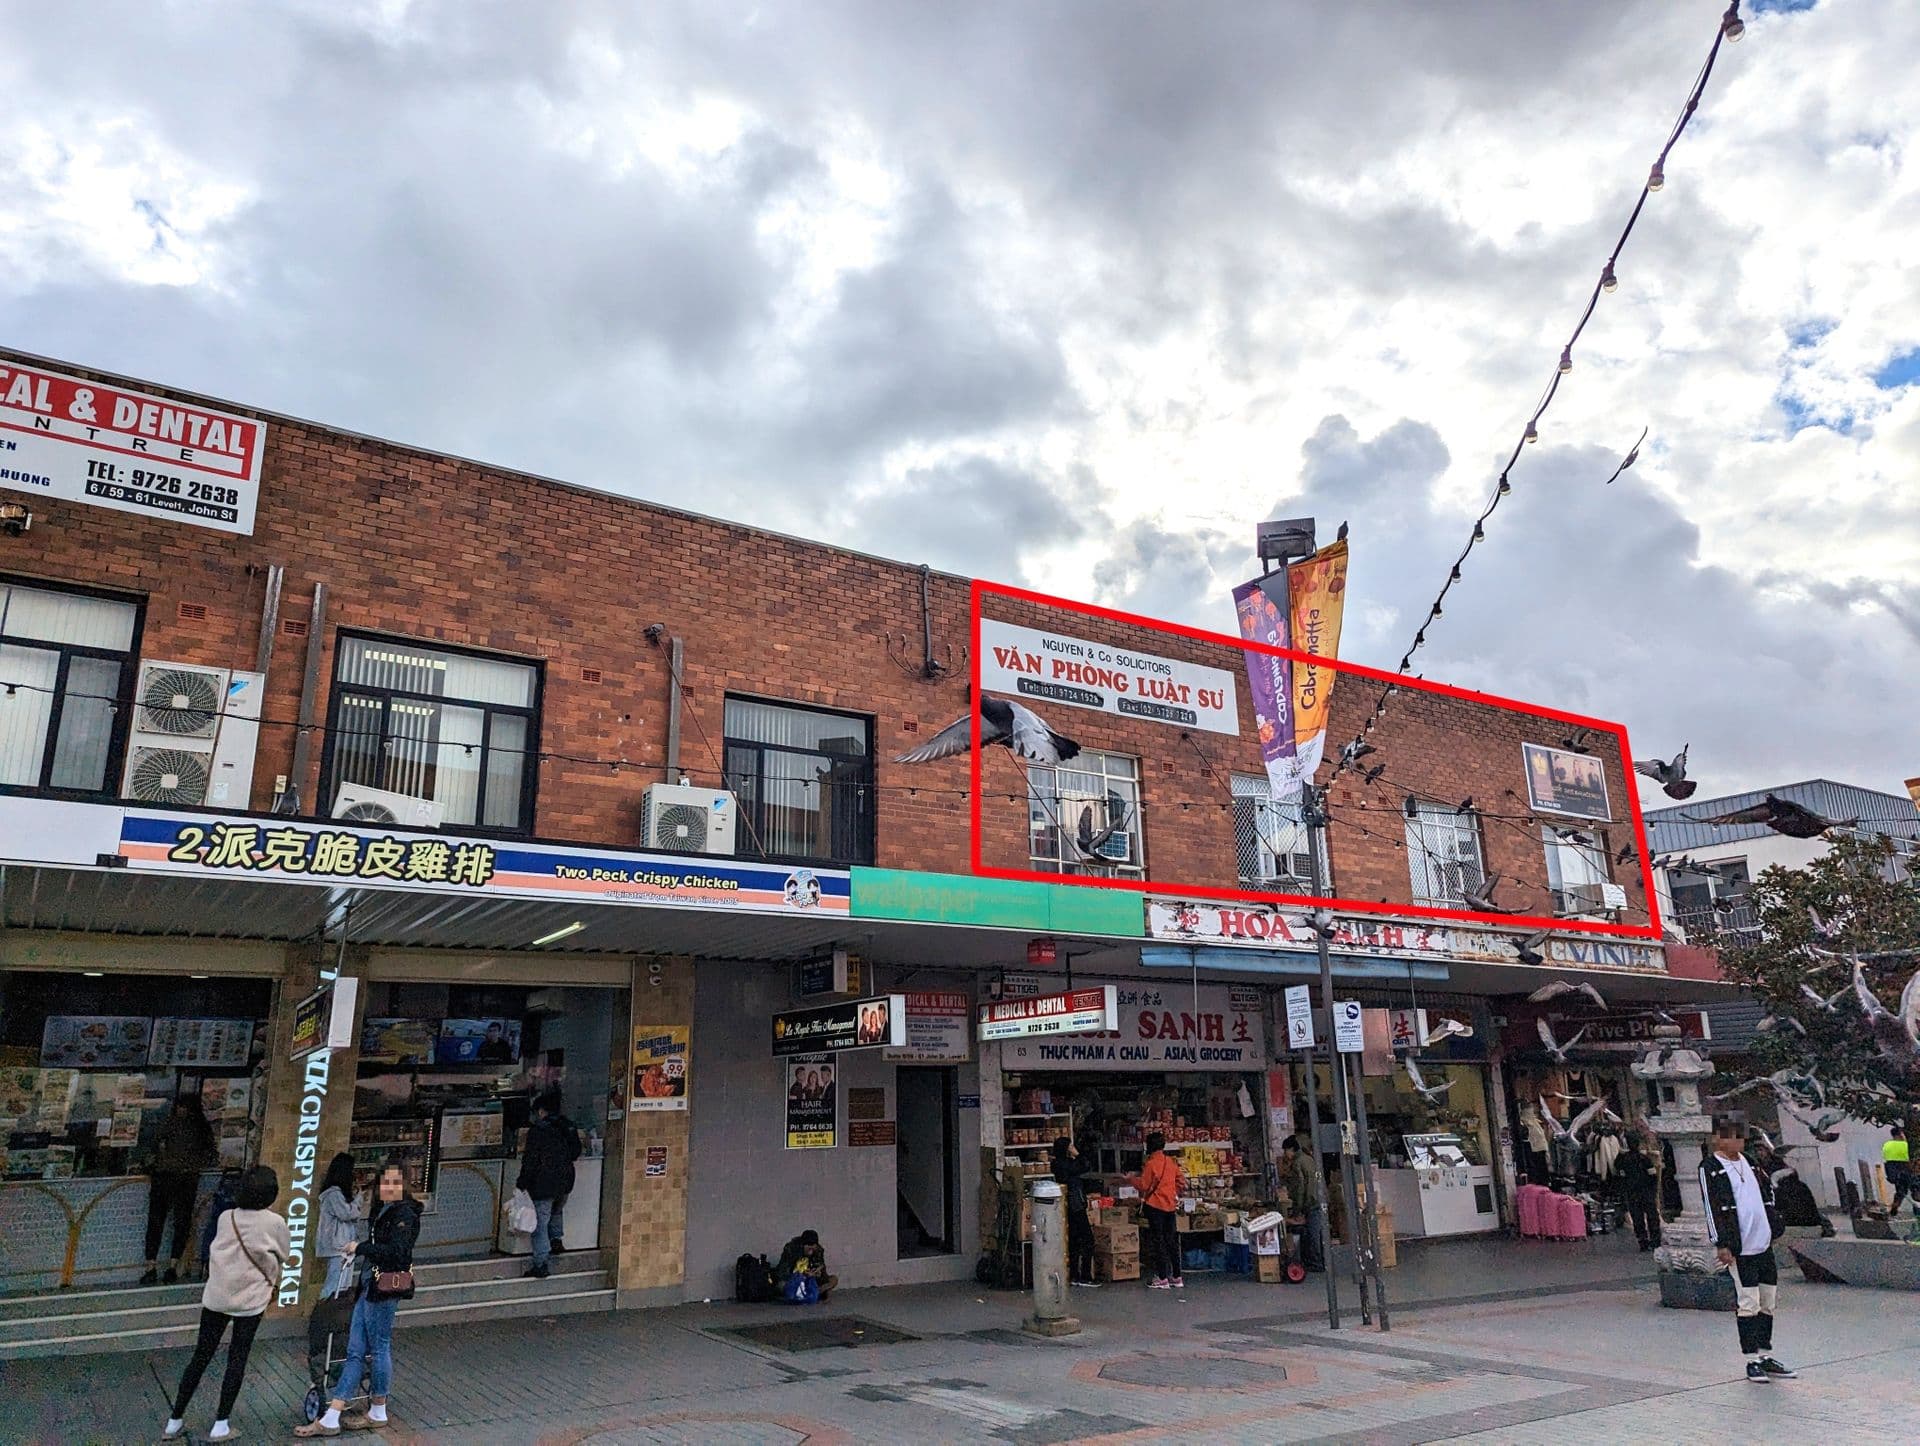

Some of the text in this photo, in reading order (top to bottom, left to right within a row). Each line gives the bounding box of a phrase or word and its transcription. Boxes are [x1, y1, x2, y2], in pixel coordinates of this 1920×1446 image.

[68, 388, 97, 422] &
[112, 396, 246, 457] DENTAL
[87, 460, 239, 506] TEL: 9726 2638
[188, 503, 218, 518] John
[220, 509, 234, 521] St
[1042, 639, 1172, 676] NGUYEN & Co SOLICITORS
[993, 645, 1225, 711] VĂN PHÒNG LUẬT SƯ
[555, 865, 739, 890] Two Peck Crispy Chicken
[1218, 910, 1295, 941] HOA
[1568, 942, 1650, 966] VINH
[906, 994, 929, 1008] DICAL
[939, 994, 967, 1008] DENTAL
[1015, 985, 1039, 994] TIGER
[994, 995, 1067, 1020] MEDICAL & DENTAL
[1138, 1010, 1226, 1042] SANH
[1231, 1013, 1254, 1043] 生
[1393, 1012, 1415, 1038] 生
[1164, 1046, 1196, 1060] ASIAN
[1200, 1047, 1243, 1062] GROCERY
[801, 1101, 822, 1109] HAIR
[287, 1094, 323, 1196] CRISPY
